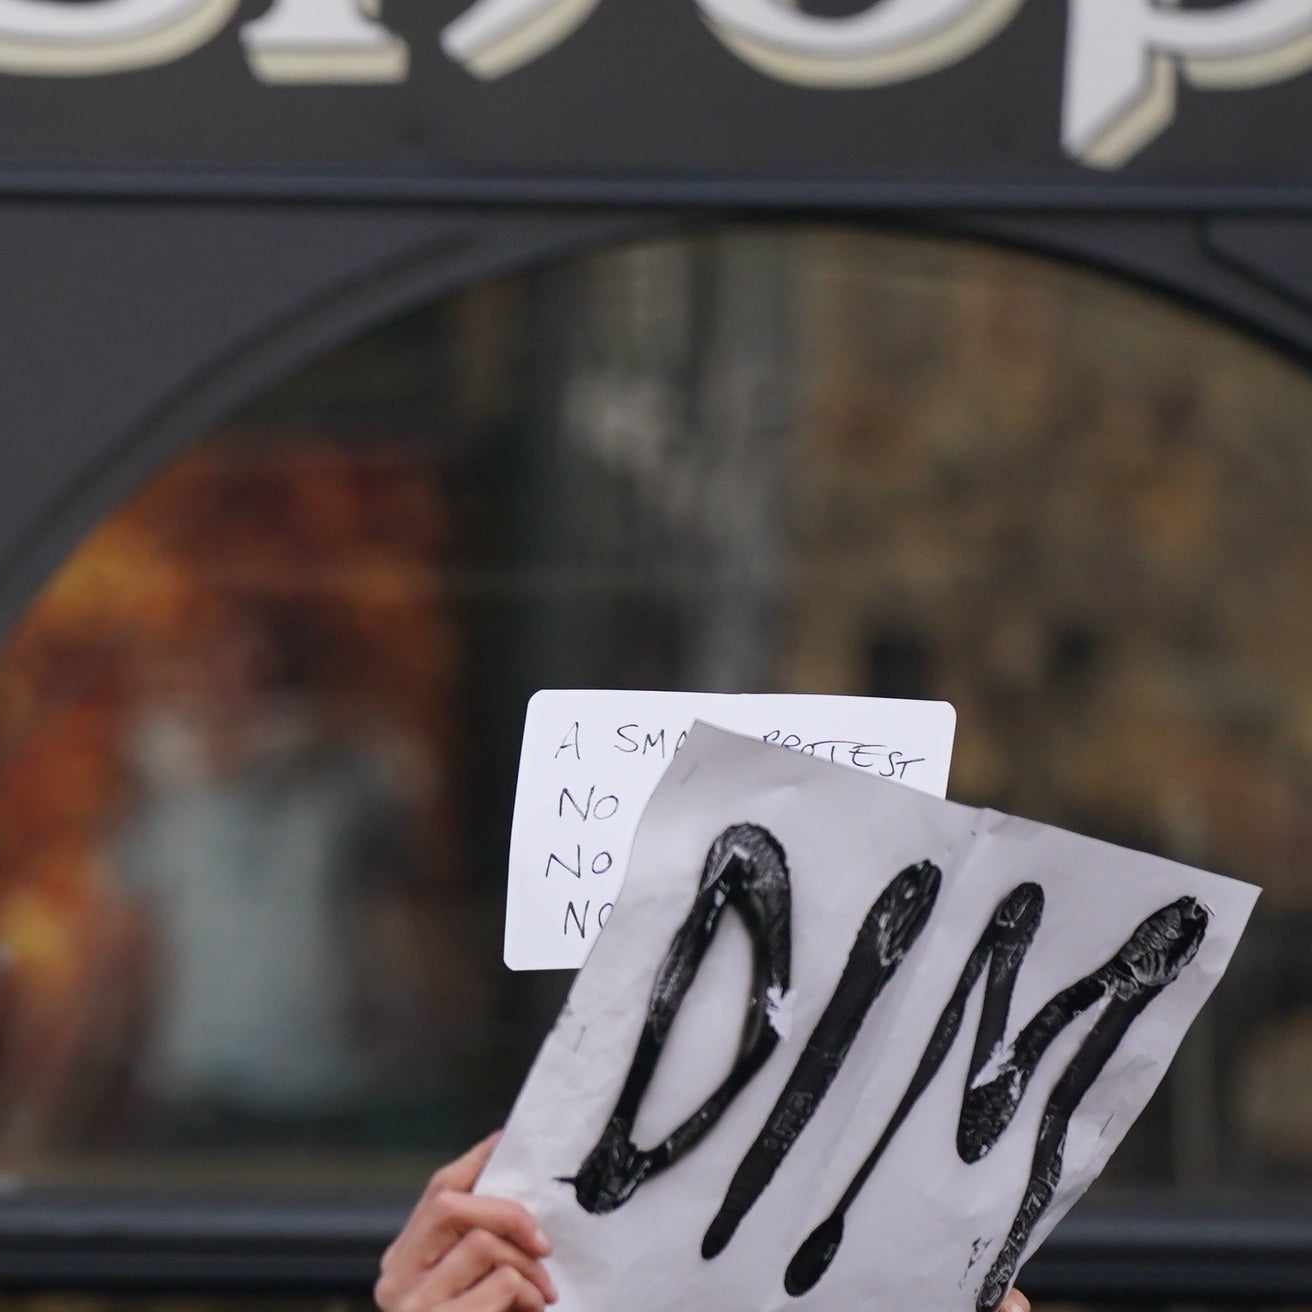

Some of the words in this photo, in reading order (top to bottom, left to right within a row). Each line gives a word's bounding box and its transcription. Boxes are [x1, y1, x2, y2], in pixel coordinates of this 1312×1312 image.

[554, 721, 581, 760] A
[558, 785, 619, 821] NO
[545, 844, 613, 879] NO
